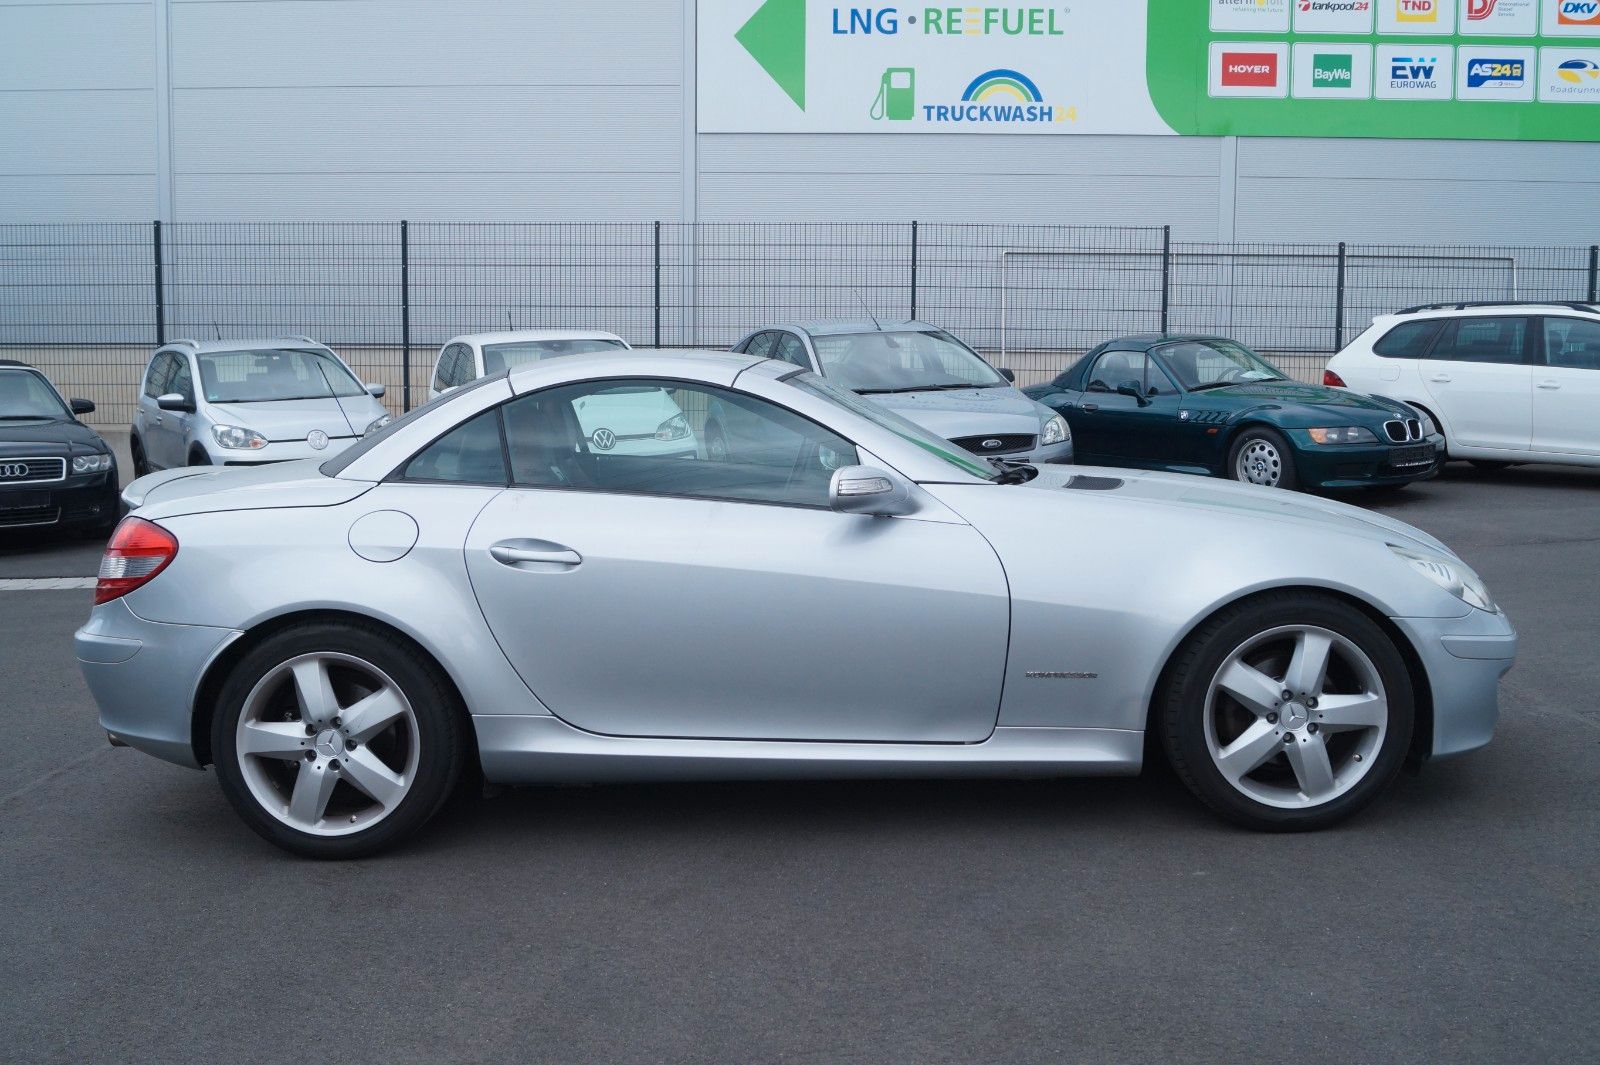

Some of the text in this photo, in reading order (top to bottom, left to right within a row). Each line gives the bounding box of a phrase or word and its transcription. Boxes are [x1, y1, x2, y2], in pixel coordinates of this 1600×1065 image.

[1312, 0, 1369, 12] tankpool24
[1403, 0, 1432, 11] TND
[1563, 3, 1597, 13] DKV
[832, 8, 898, 35] LNG
[1229, 64, 1270, 74] HOYER
[1314, 68, 1351, 82] BayWa
[1390, 81, 1437, 89] EUROWAG
[1550, 86, 1600, 94] Roadrunne
[923, 105, 1077, 122] TRUCKWASH24
